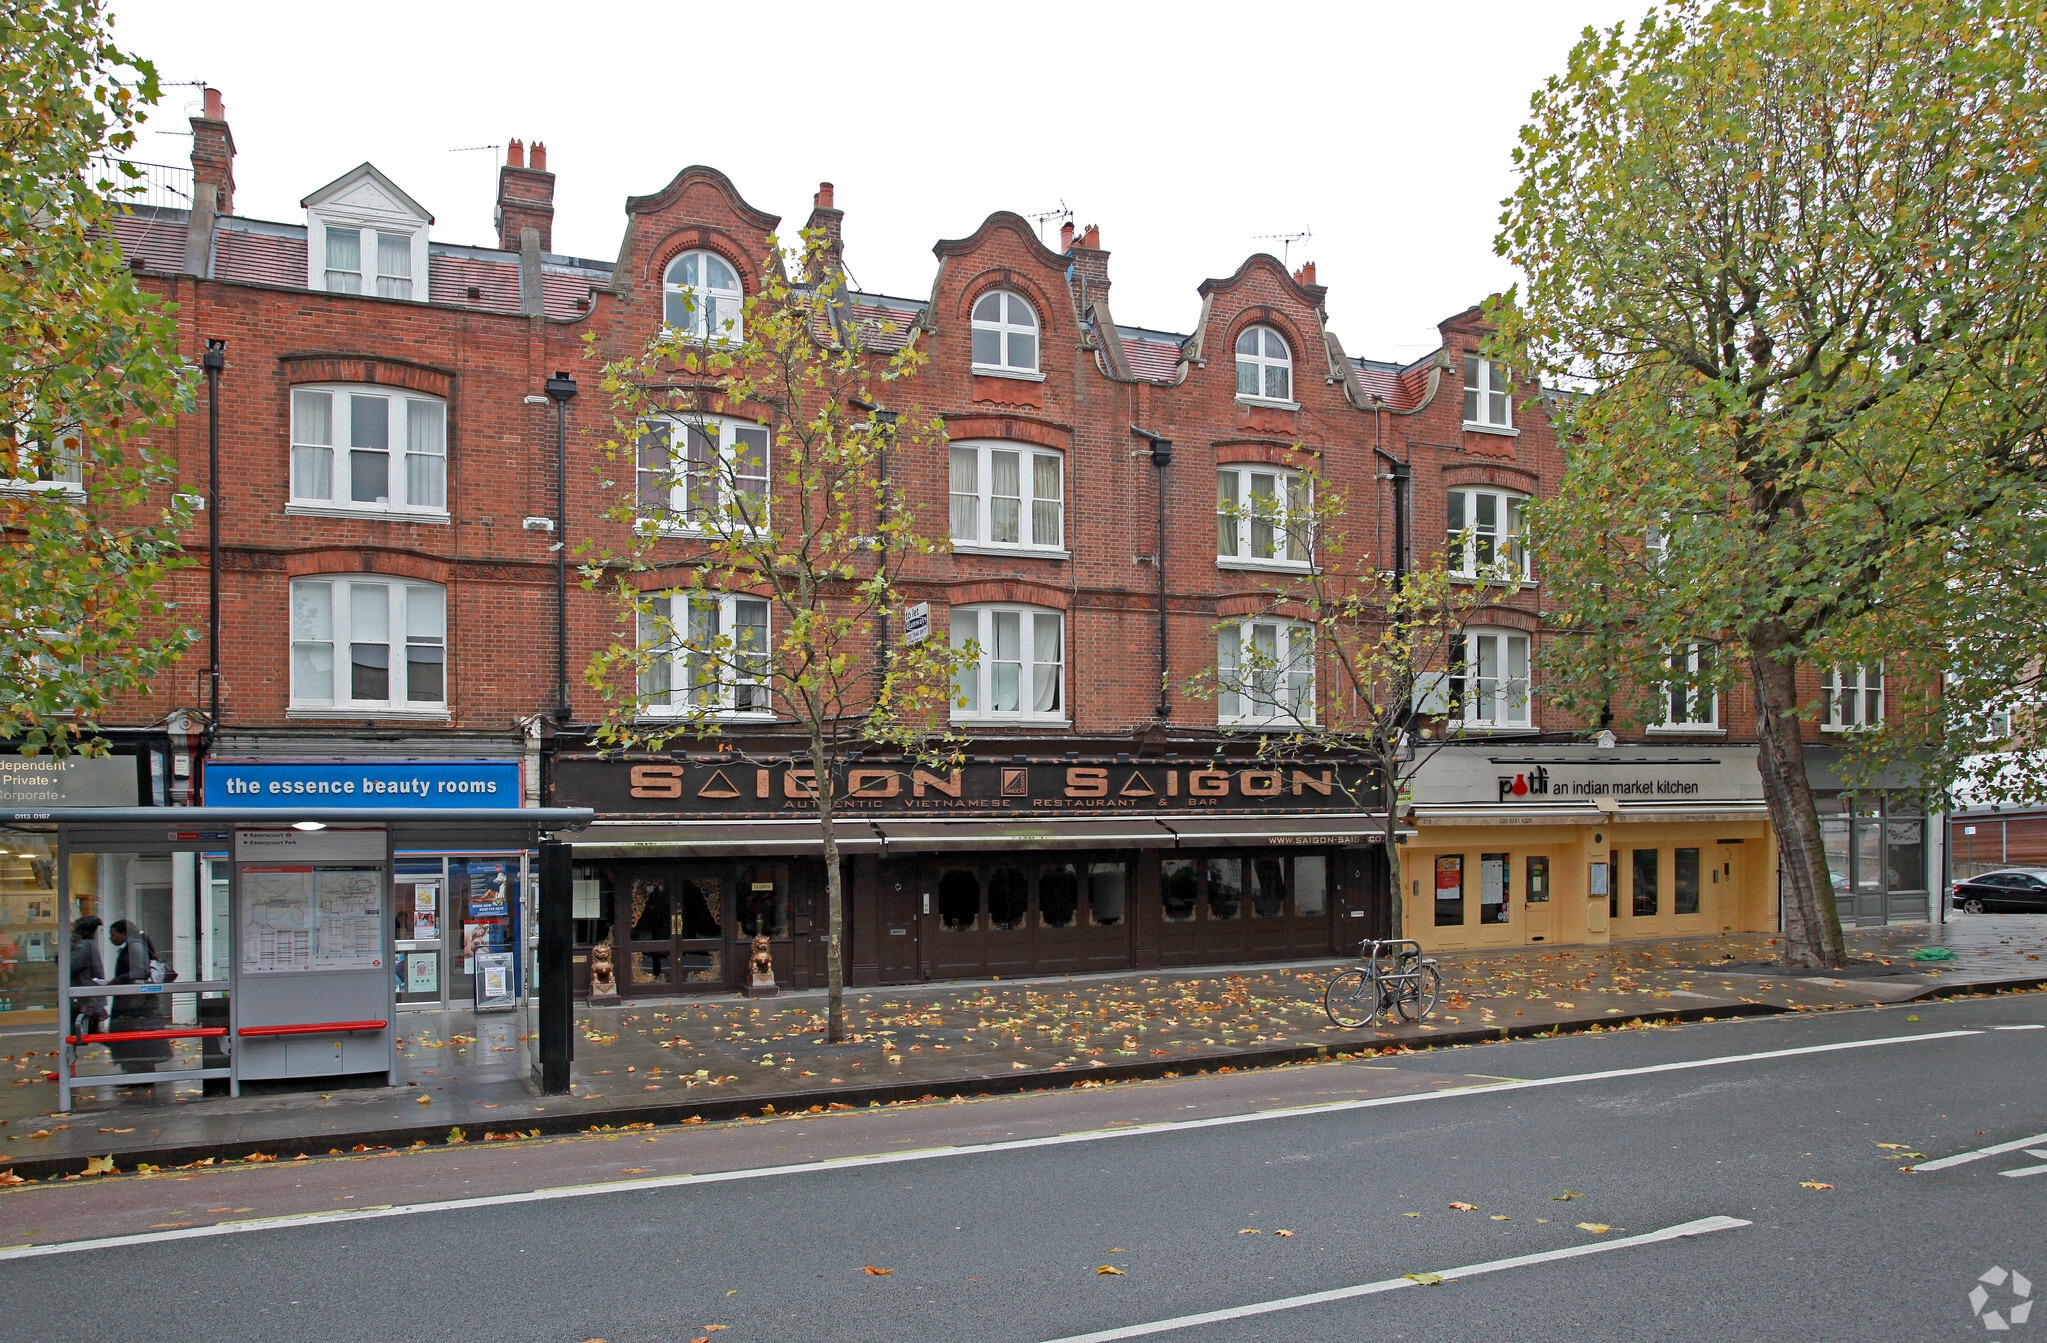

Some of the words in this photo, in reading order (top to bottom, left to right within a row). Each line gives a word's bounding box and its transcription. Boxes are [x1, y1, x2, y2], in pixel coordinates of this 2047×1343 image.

[0, 760, 66, 773] dependent
[3, 775, 48, 785] Private
[226, 777, 261, 794] the
[268, 778, 355, 794] essence
[362, 778, 430, 797] beauty
[437, 781, 497, 794] rooms
[630, 765, 962, 798] SAIGON
[1064, 767, 1332, 797] SAIGON
[1553, 783, 1569, 794] an
[1572, 781, 1609, 795] indian
[1612, 779, 1654, 794] market
[1657, 779, 1699, 794] kitchen
[0, 790, 58, 801] Corporate
[783, 800, 883, 808] AUTENTIC
[905, 799, 1011, 808] VIETNAMESE
[1033, 799, 1137, 807] RESTAURANT
[1158, 798, 1168, 806] &
